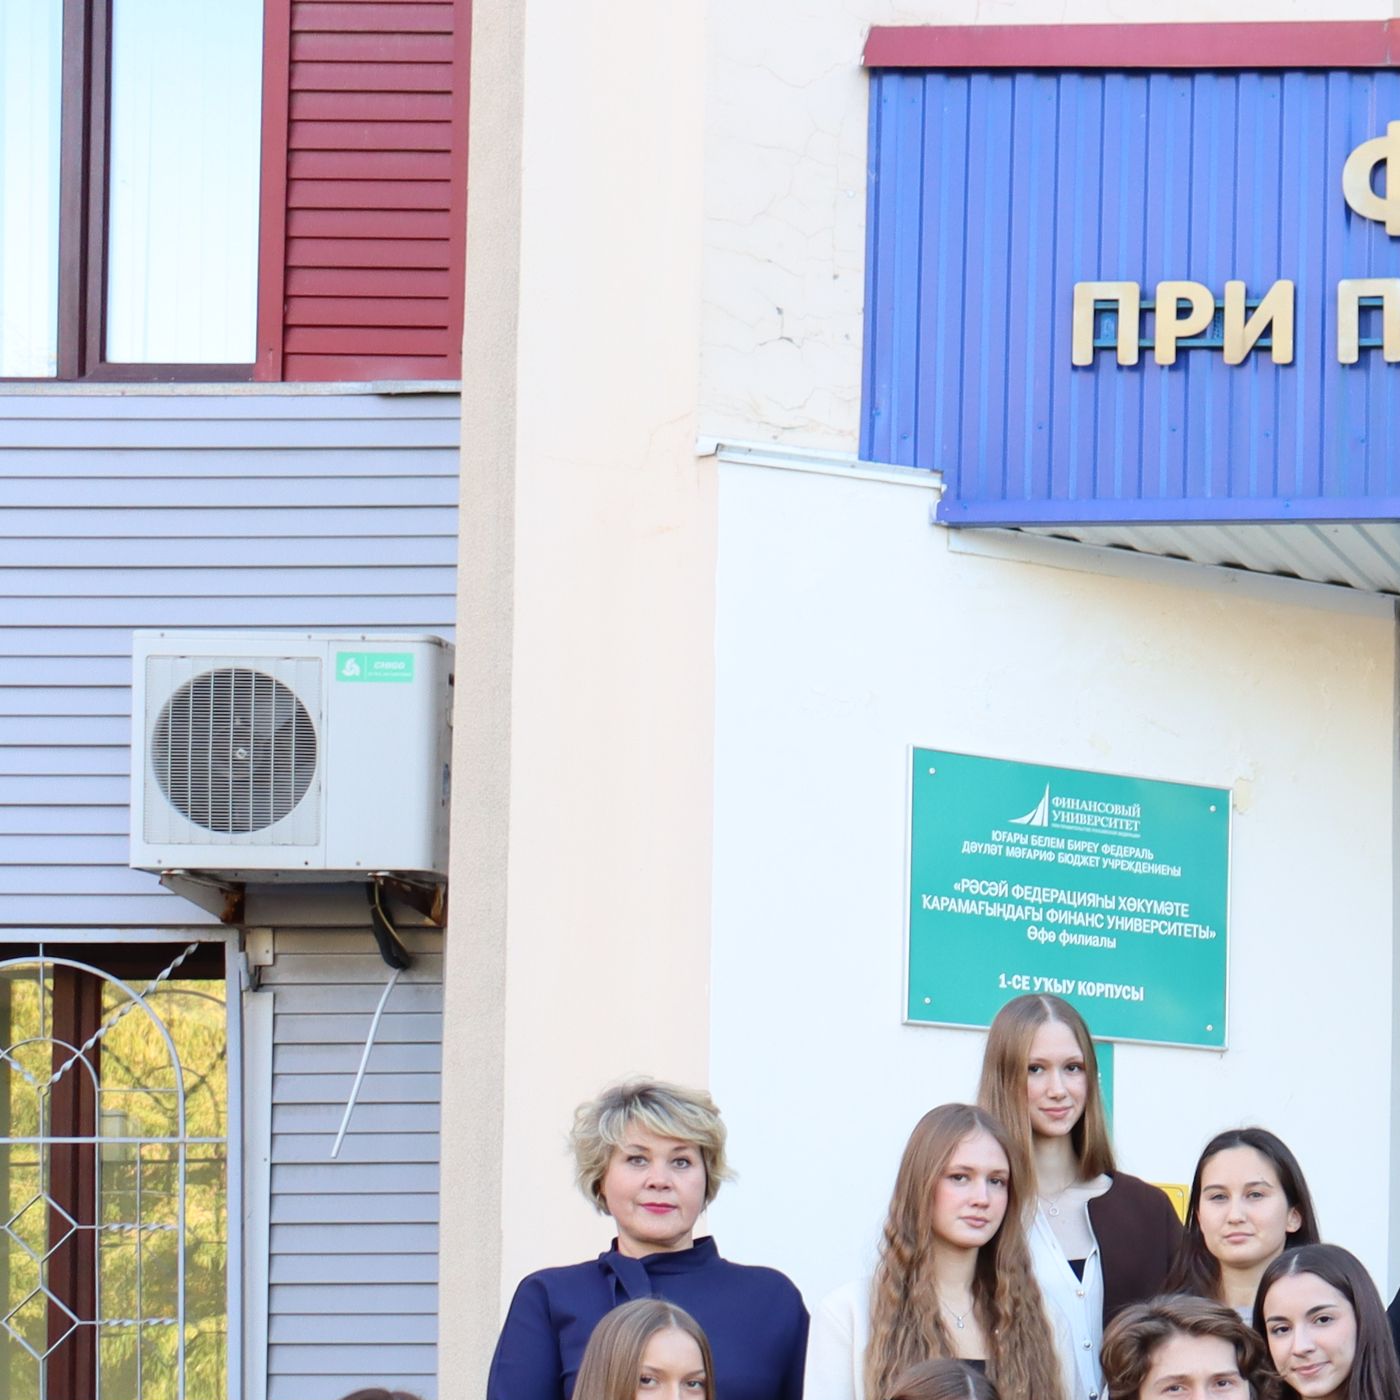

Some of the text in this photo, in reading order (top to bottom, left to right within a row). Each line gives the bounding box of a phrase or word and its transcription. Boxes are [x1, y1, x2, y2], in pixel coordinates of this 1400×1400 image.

[1071, 280, 1293, 366] ПРИ
[1052, 796, 1141, 817] ФИНАНСОВЫЙ
[1052, 810, 1140, 831] УНИВЕРСИТЕТ
[1031, 835, 1064, 849] БЕЛЕМ
[1101, 843, 1154, 860] ФЕДЕРАЛЬ
[1058, 852, 1100, 868] БЮДЖЕТ
[1046, 908, 1104, 929] ФИНАНС
[1107, 916, 1216, 940] УНИВЕРСИТЕТЫ»
[1059, 929, 1117, 949] филиалы
[998, 973, 1030, 991] 1-СЕ
[1078, 980, 1144, 1001] КОРПУСЫ
